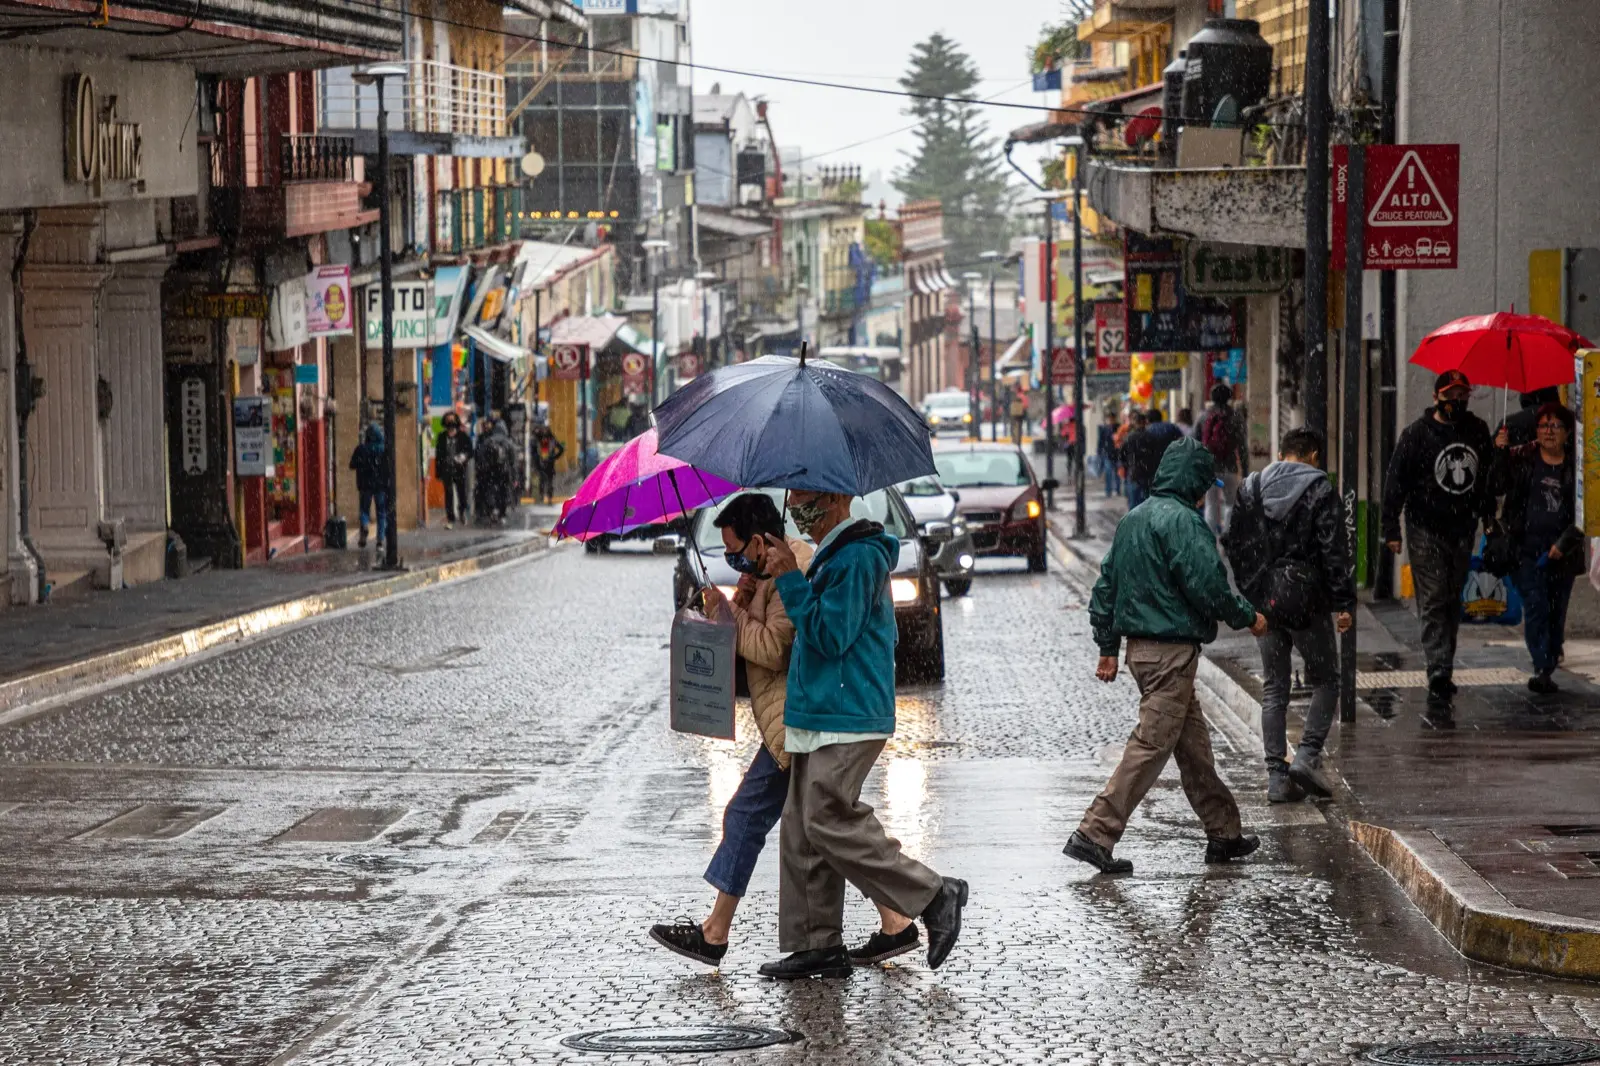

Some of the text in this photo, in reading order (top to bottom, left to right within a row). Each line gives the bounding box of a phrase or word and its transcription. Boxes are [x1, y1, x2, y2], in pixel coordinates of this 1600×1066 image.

[1336, 163, 1348, 203] Xalapa
[1390, 193, 1431, 206] ALTO
[1376, 210, 1445, 220] CRUCE PEATONAL
[368, 288, 425, 312] FTO
